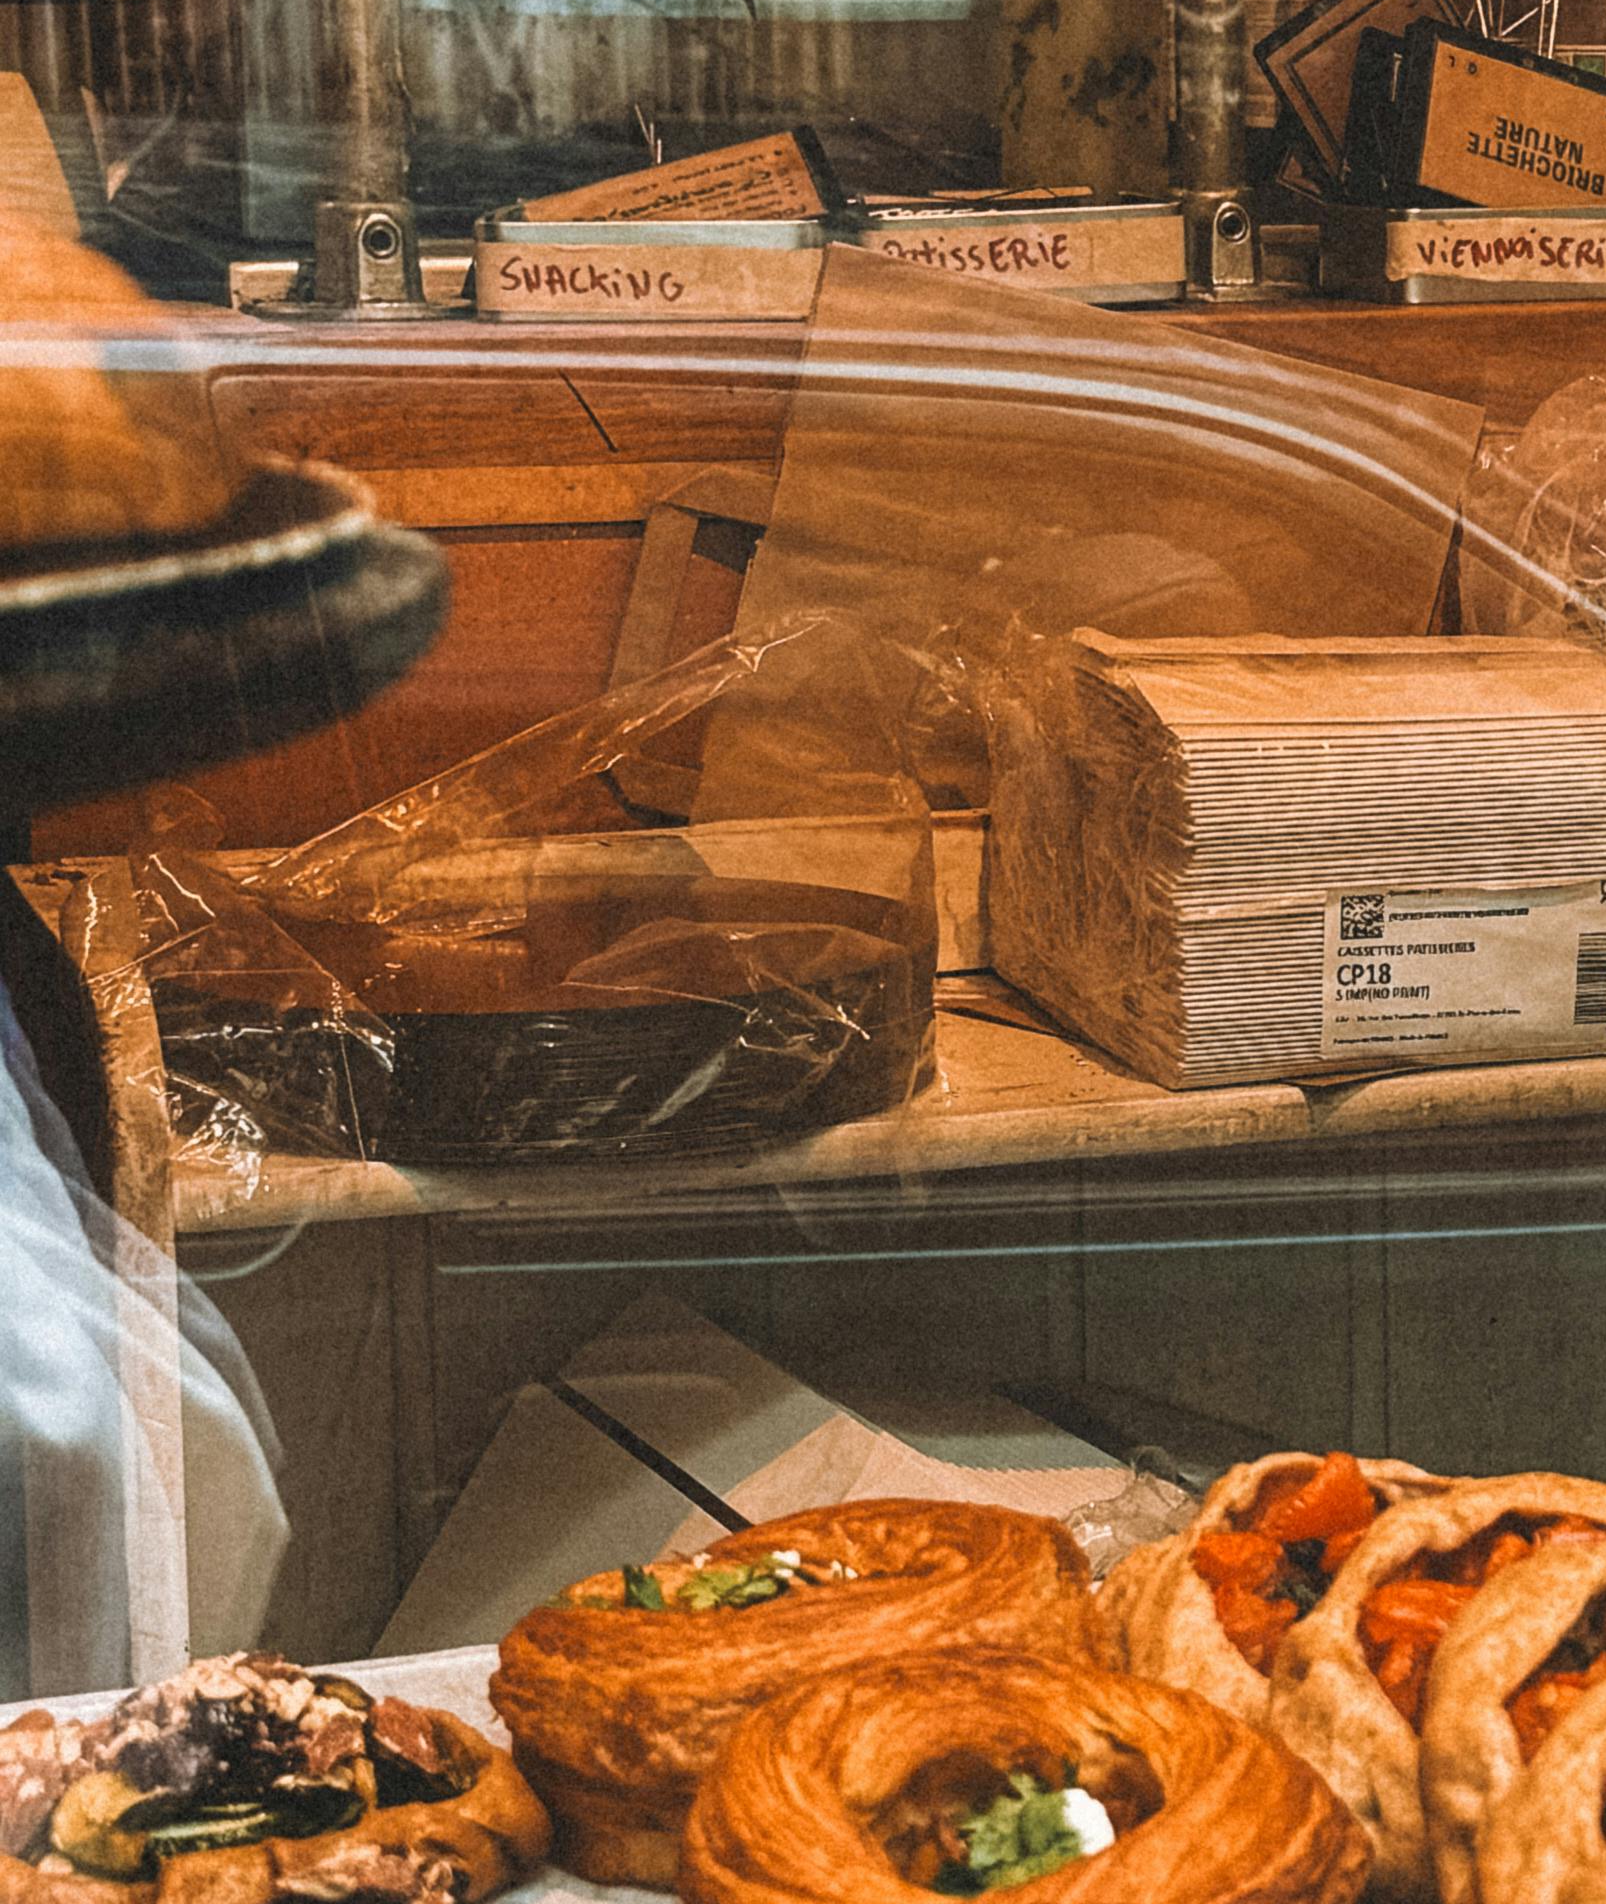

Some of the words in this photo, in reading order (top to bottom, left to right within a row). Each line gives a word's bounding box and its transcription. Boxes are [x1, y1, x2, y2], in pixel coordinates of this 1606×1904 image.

[1466, 130, 1605, 196] BRIOCHETTE
[1495, 116, 1584, 165] NATURE
[1336, 962, 1392, 986] CP18
